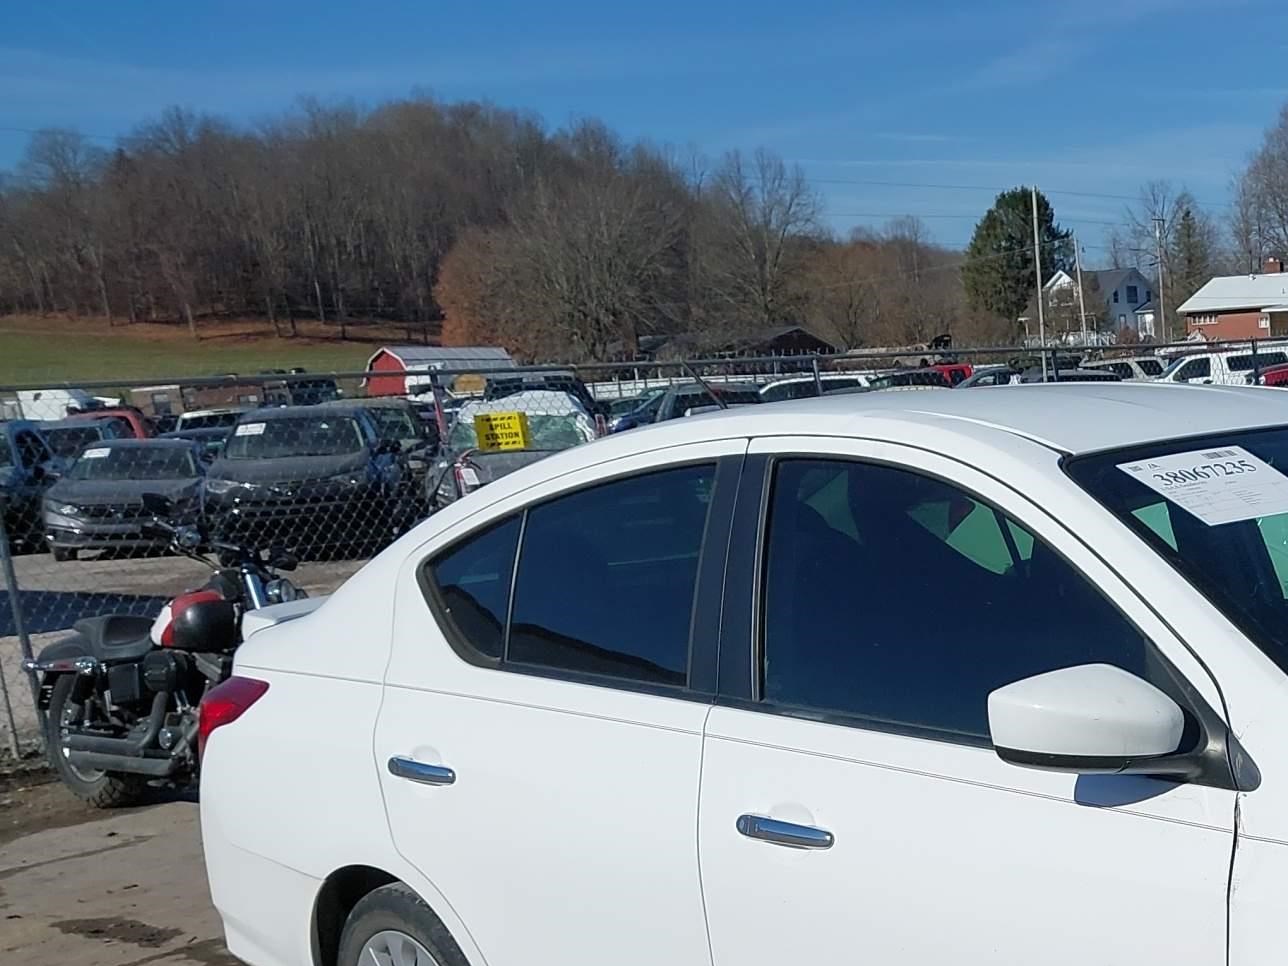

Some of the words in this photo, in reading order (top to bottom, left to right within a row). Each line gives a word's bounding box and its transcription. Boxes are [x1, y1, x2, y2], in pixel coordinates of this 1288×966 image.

[489, 423, 513, 431] SPILL
[485, 432, 520, 440] STATION
[1153, 461, 1257, 486] 38067235
